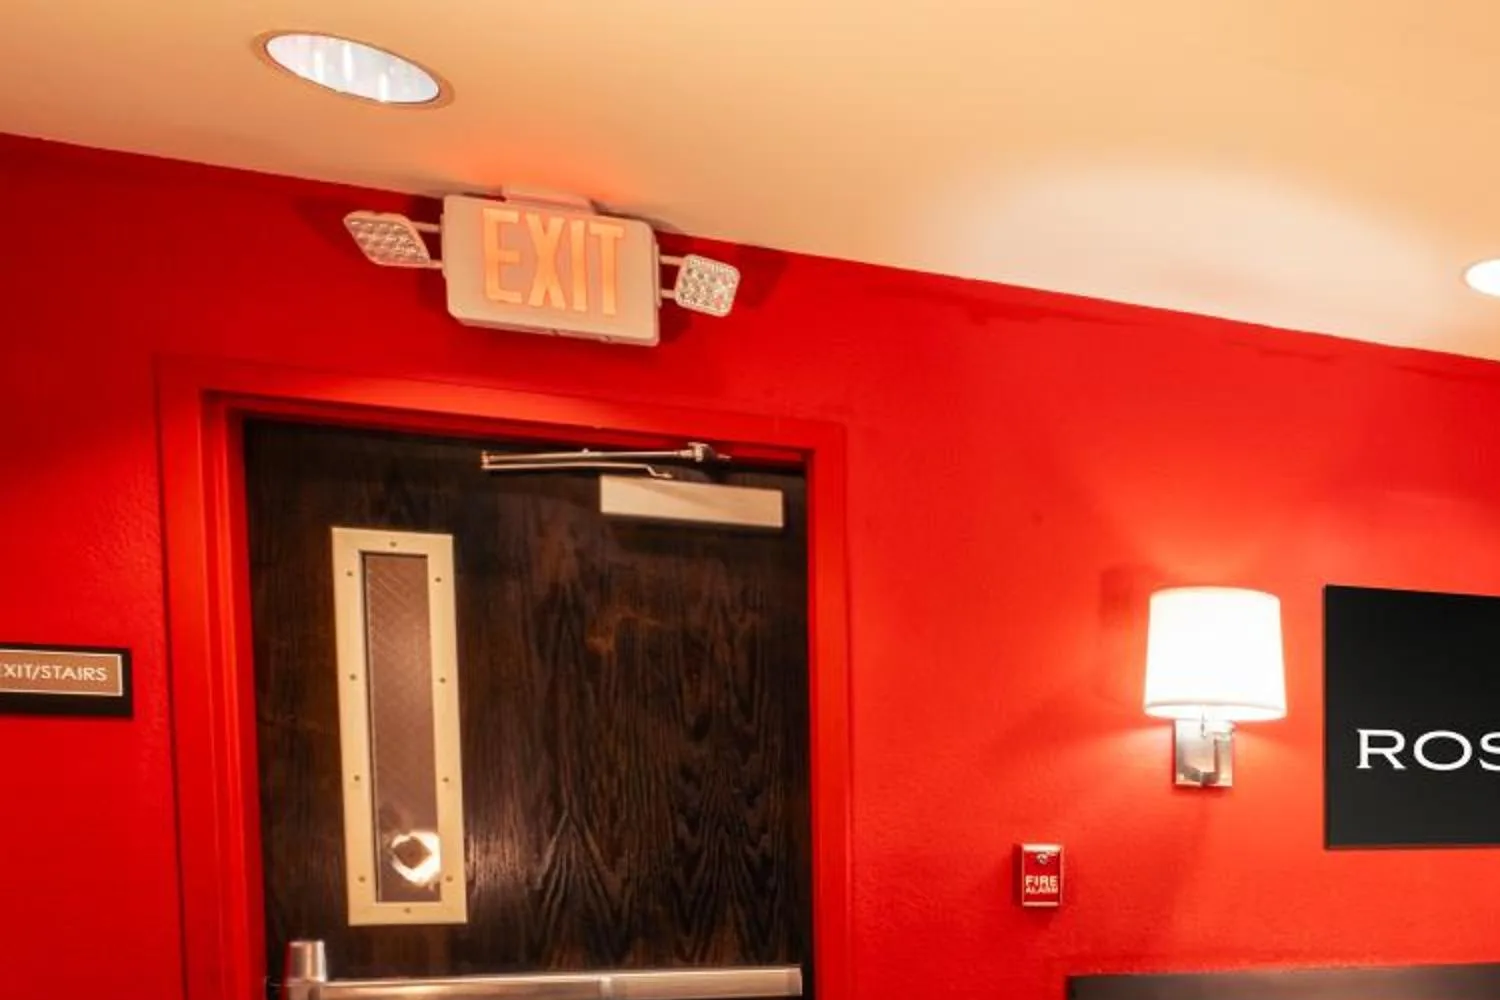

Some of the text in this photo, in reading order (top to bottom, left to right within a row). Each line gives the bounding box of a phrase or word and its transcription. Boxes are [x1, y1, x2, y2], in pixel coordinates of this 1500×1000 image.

[482, 208, 625, 315] EXIT
[0, 663, 108, 681] XIT/STAIRS
[1025, 875, 1058, 887] FIRE
